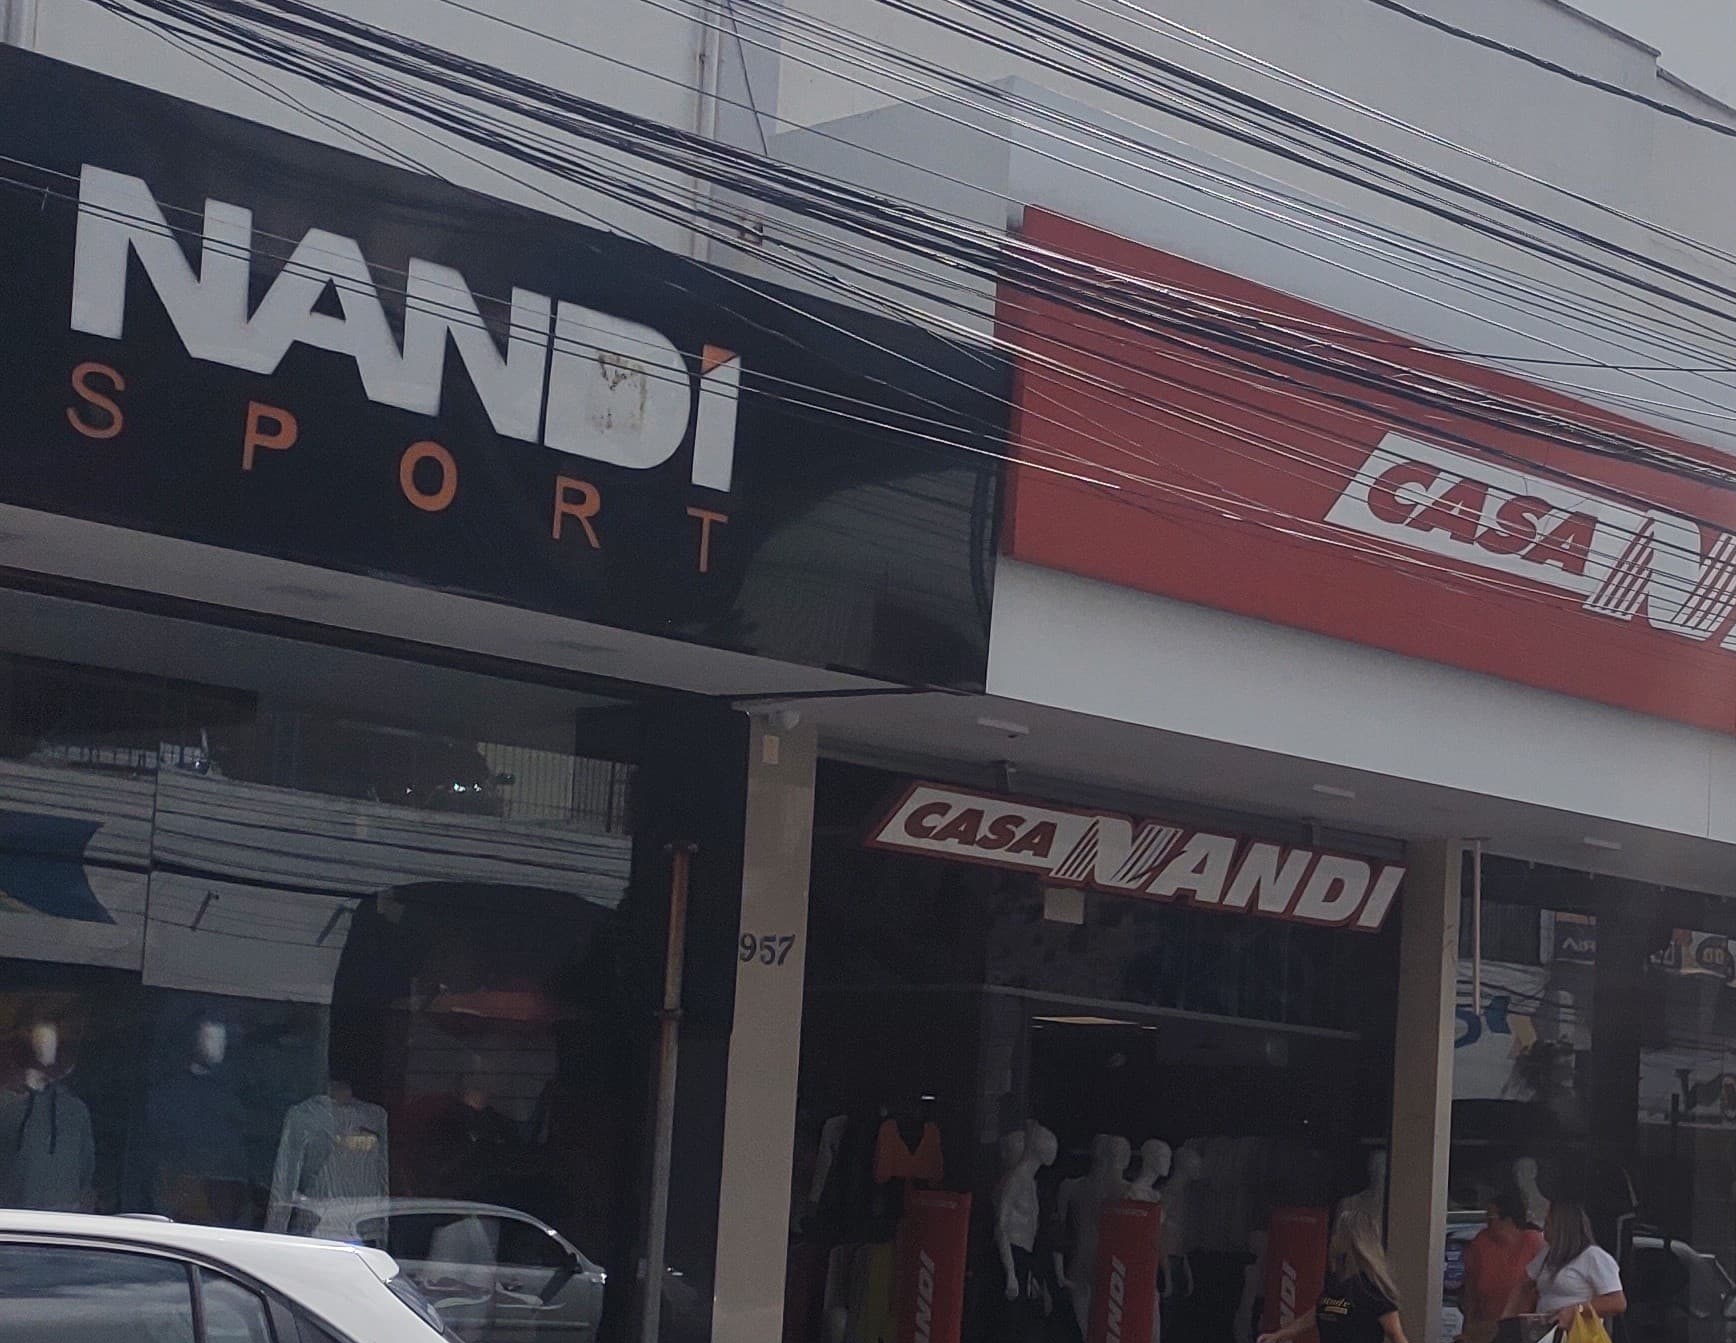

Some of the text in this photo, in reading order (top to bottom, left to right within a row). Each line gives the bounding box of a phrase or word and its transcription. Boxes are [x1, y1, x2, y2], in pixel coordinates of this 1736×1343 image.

[1367, 461, 1597, 576] CASA
[903, 801, 1406, 928] CASA NANDI
[739, 932, 795, 966] 957
